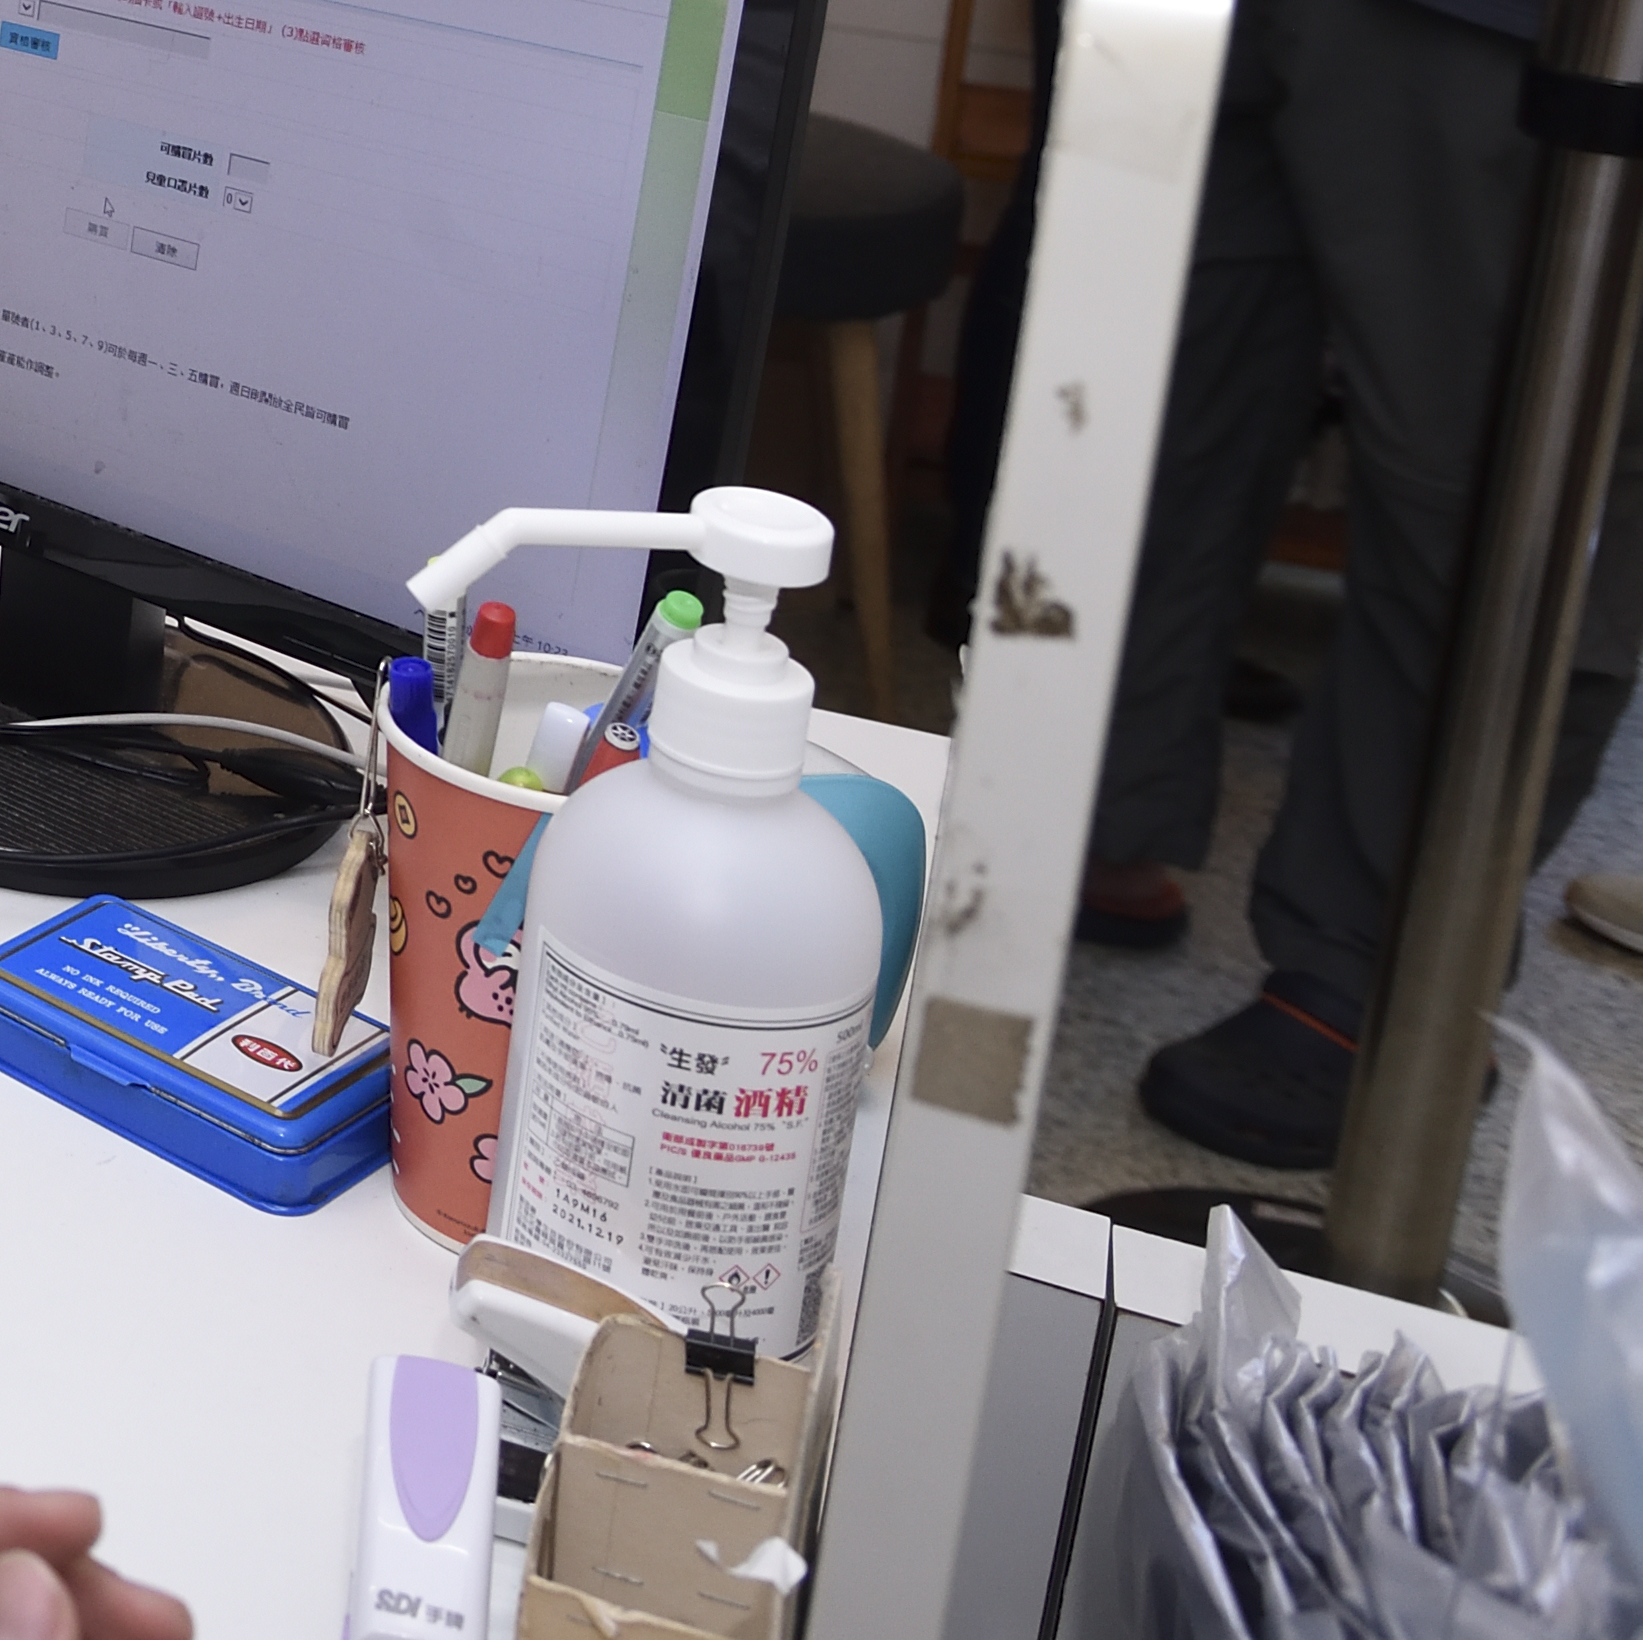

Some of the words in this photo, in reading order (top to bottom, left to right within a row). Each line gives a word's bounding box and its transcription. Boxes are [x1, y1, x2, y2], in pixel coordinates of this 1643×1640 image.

[226, 193, 232, 204] 0
[59, 935, 169, 984] Stamp
[164, 979, 223, 1012] Pad
[62, 965, 80, 974] NO
[82, 972, 103, 987] INK
[106, 983, 161, 1014] REQUIRED
[35, 967, 76, 990] ALWAYS
[78, 986, 115, 1008] READY
[116, 1003, 141, 1021] FOR
[144, 1019, 168, 1034] USE
[760, 1049, 818, 1076] 75%
[661, 1081, 727, 1115] 清菌
[734, 1085, 808, 1118] 酒精
[652, 1108, 707, 1129] Cleansing
[711, 1119, 750, 1131] Alcohol
[753, 1122, 775, 1131] 75%
[552, 1204, 624, 1246] 2021.12.19
